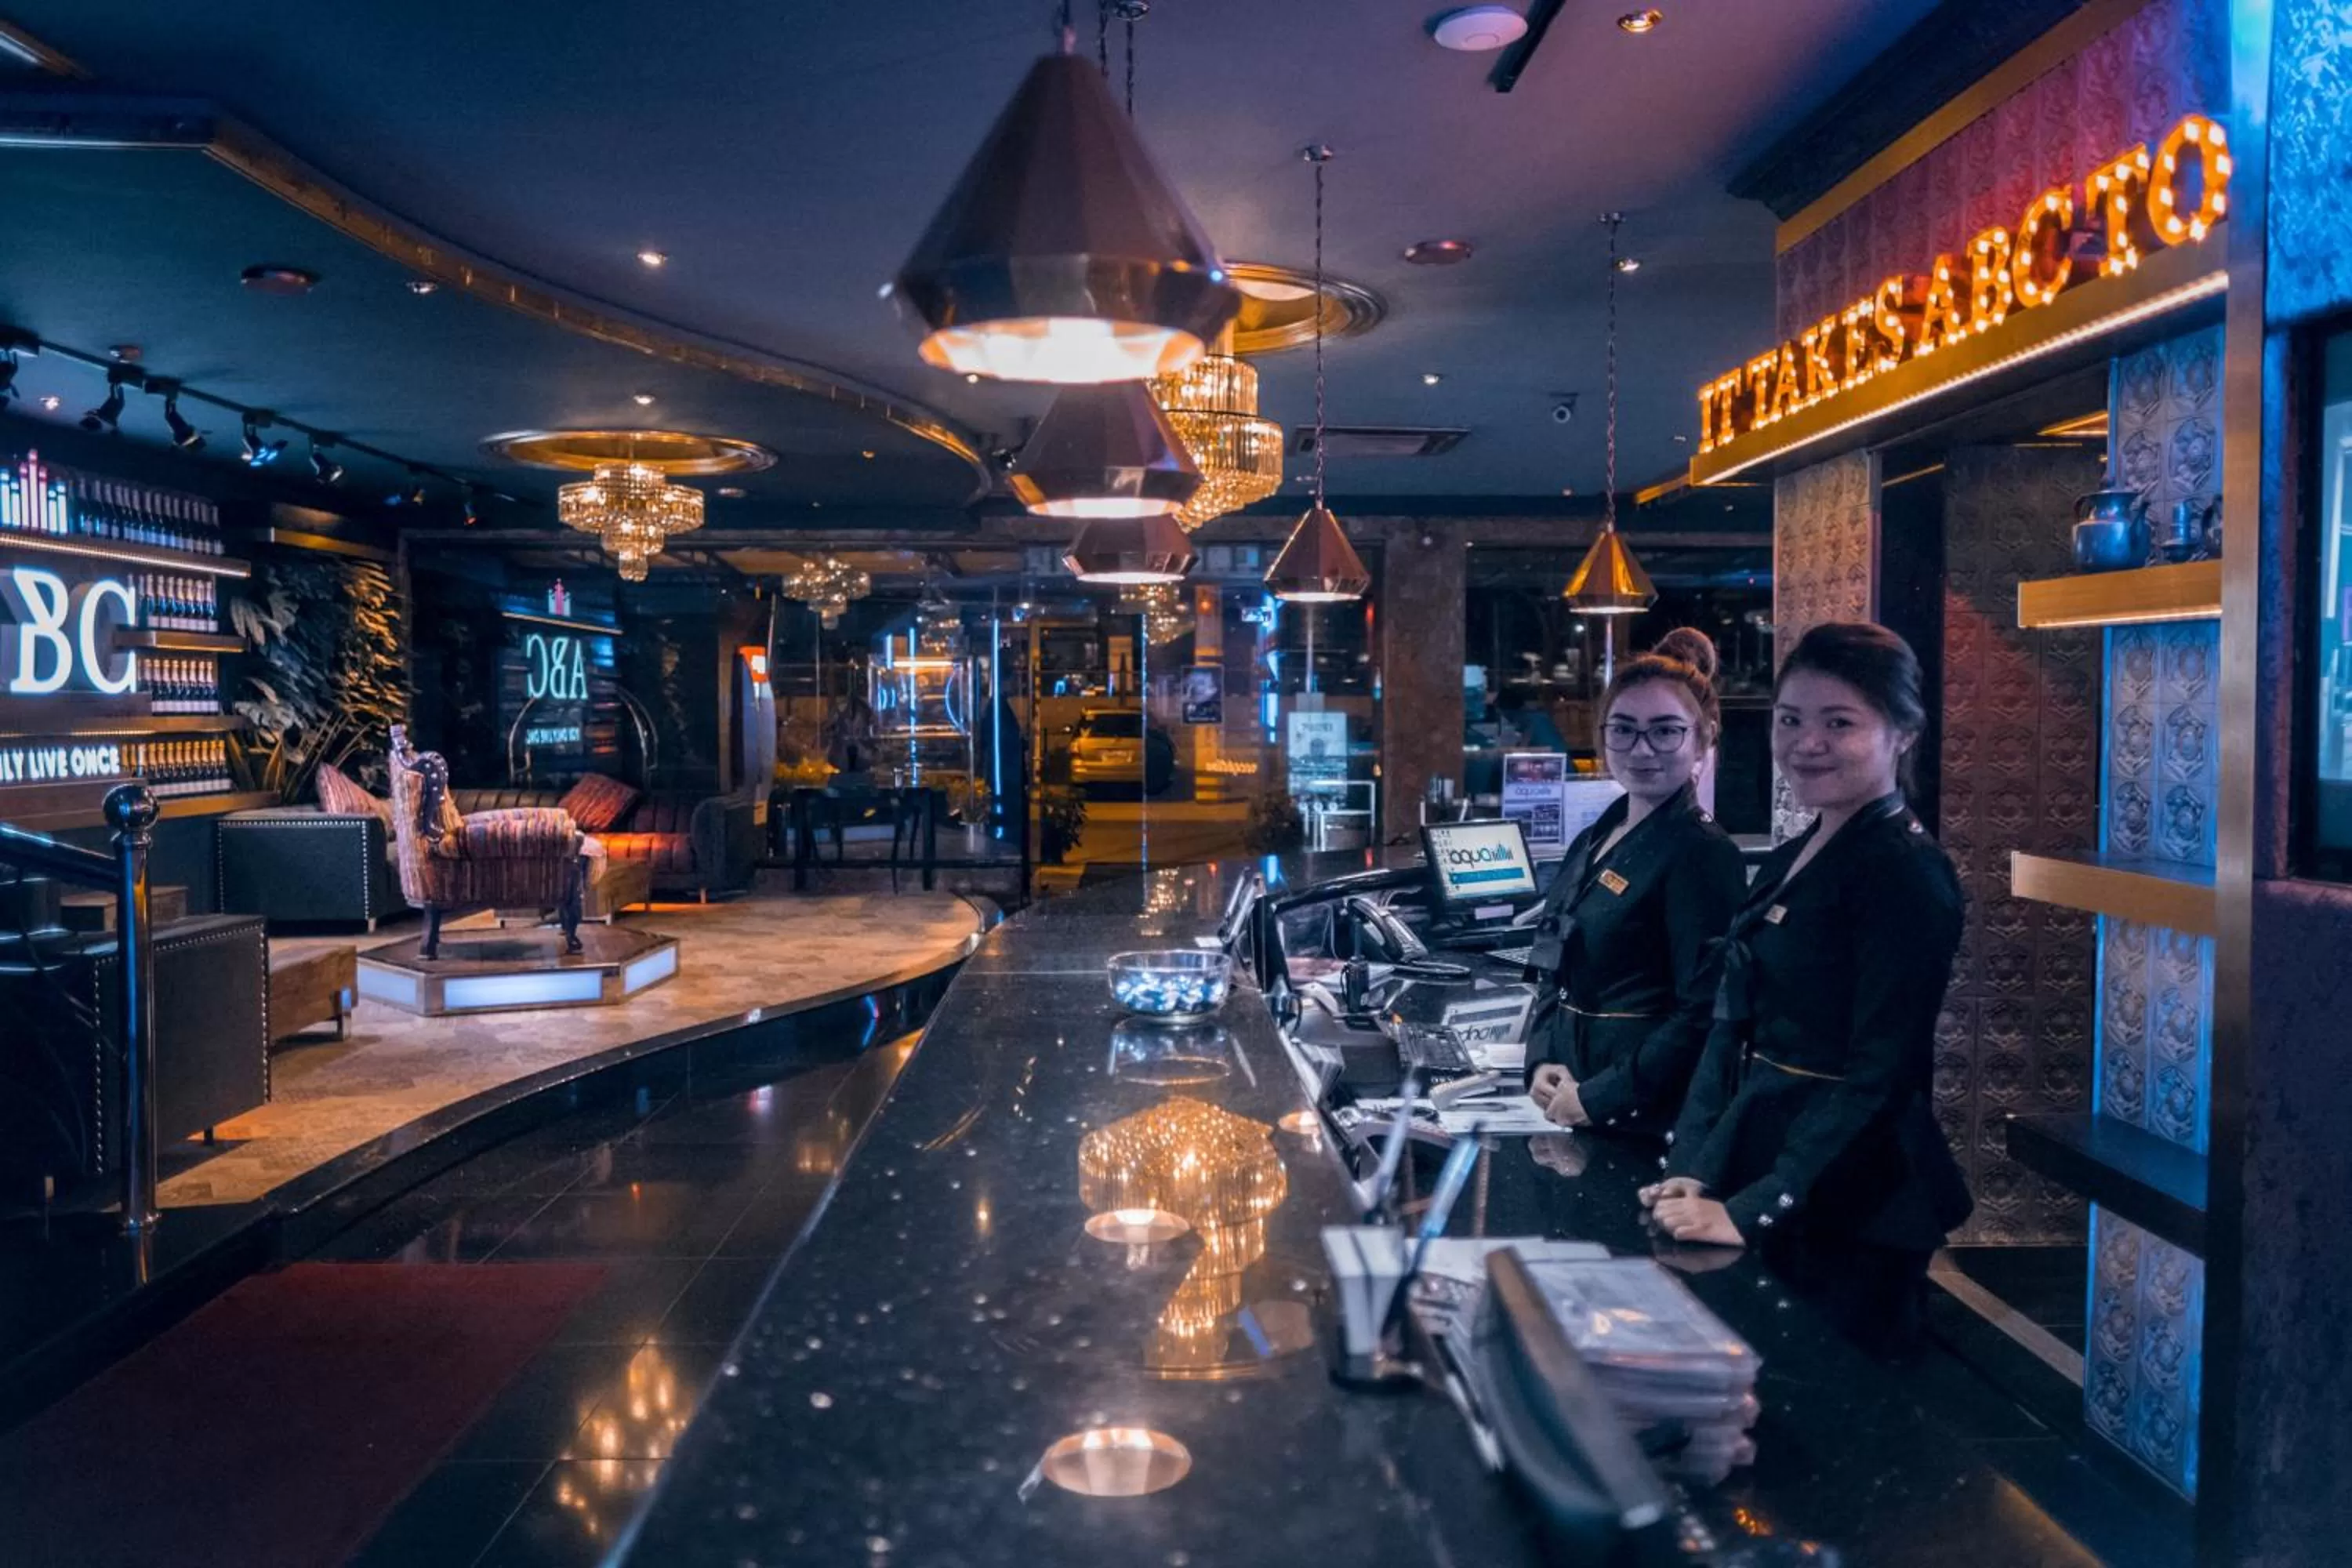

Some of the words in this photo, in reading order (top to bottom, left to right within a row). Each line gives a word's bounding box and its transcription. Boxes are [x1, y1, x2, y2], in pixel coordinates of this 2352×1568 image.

[1697, 368, 1741, 452] IT
[1746, 275, 1904, 430] TAKES
[1915, 185, 2073, 357] ABC
[2085, 114, 2232, 277] TO
[0, 747, 24, 782] LY
[29, 746, 68, 780] LIVE
[71, 745, 119, 776] ONCE
